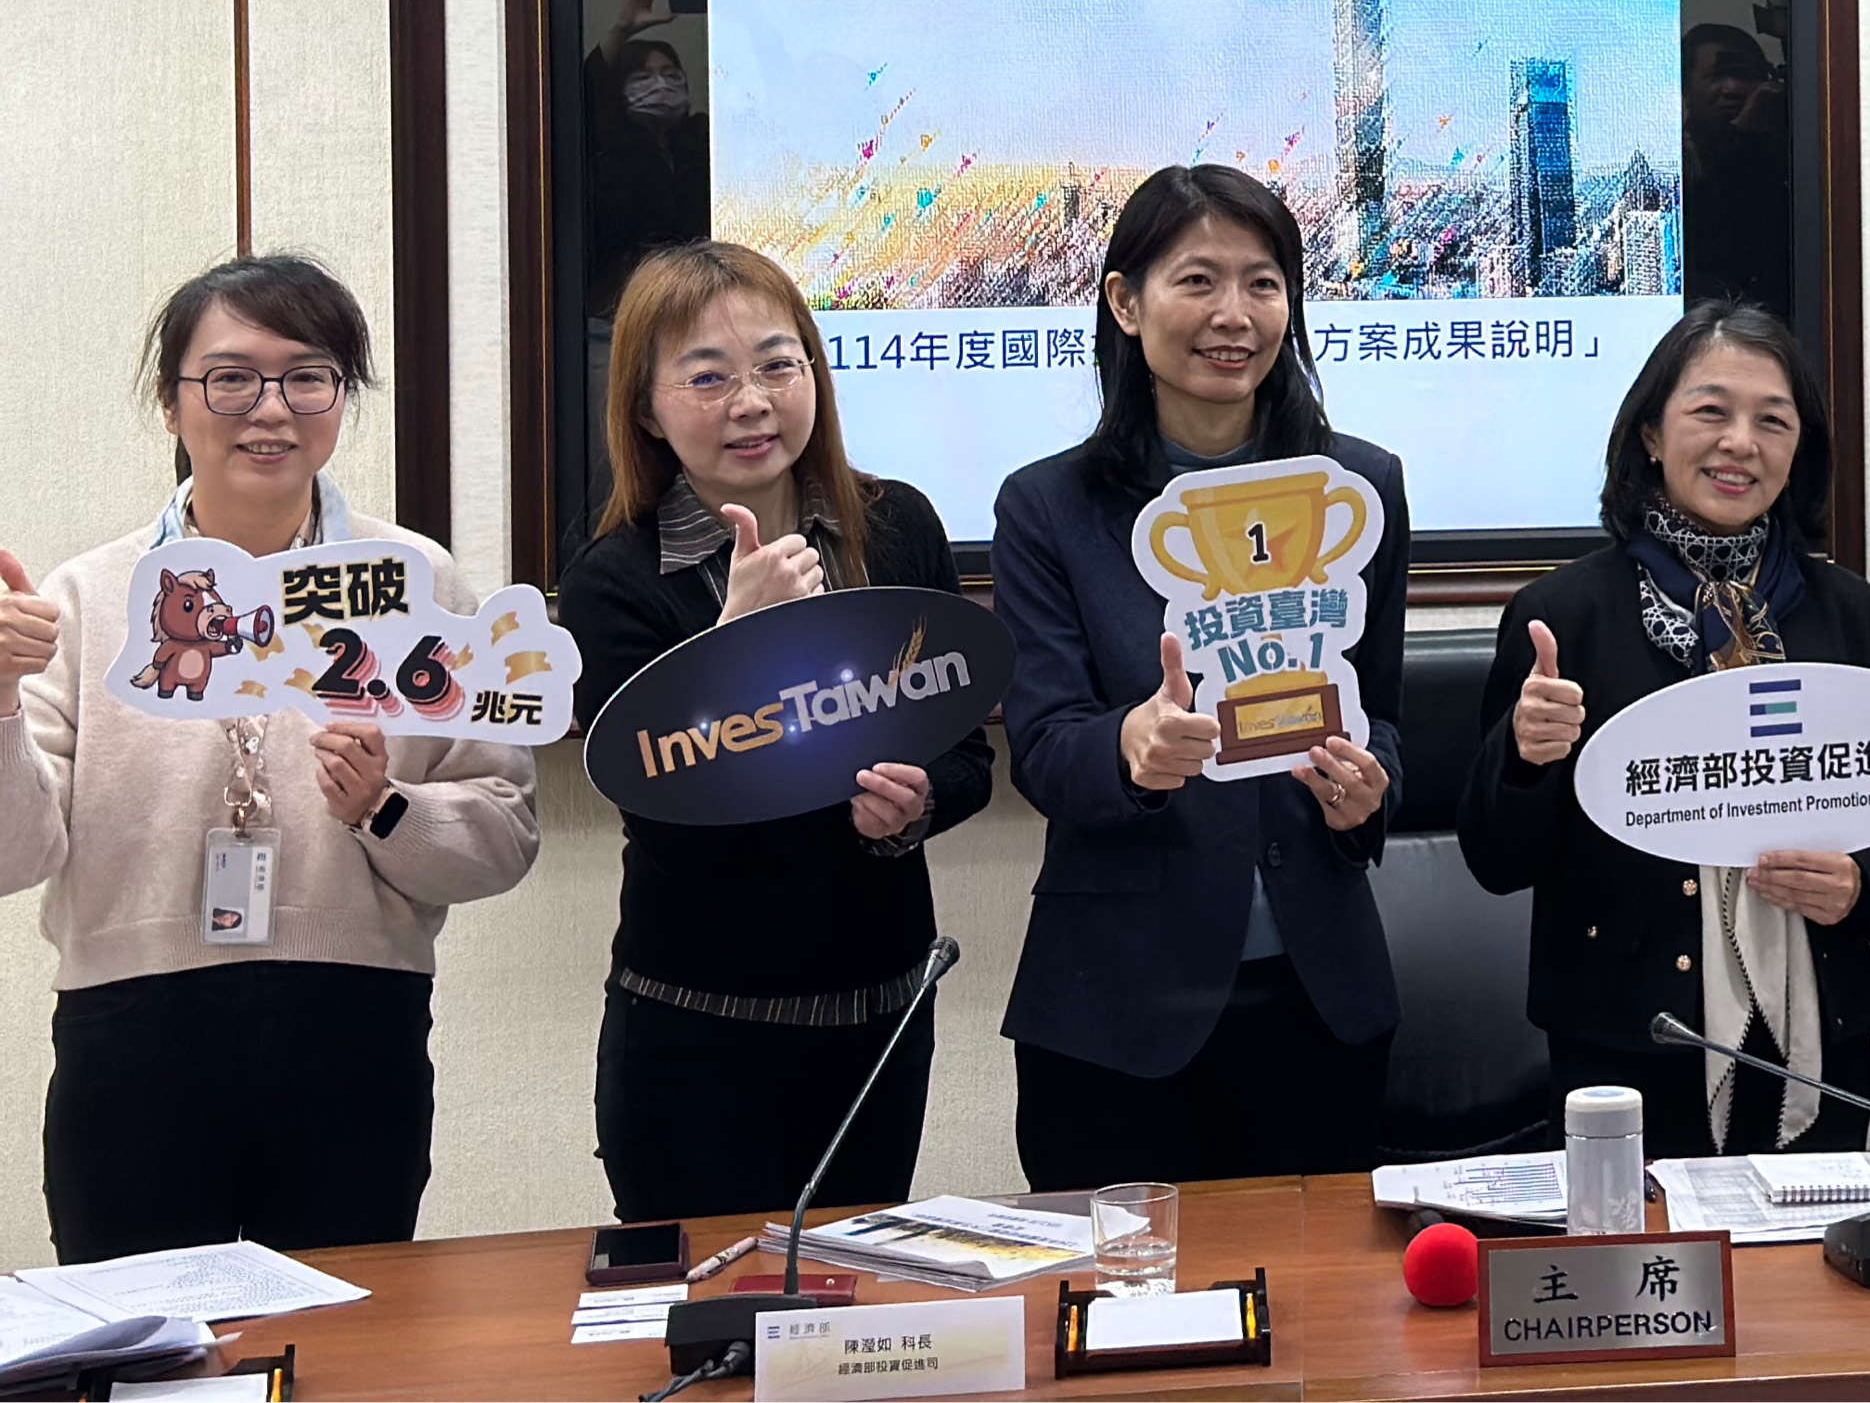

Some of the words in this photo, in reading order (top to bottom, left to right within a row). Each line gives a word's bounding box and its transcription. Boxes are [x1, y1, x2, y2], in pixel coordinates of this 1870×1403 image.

[828, 329, 1098, 370] 114年度國際
[1313, 320, 1600, 362] 方案成果說明」
[1247, 523, 1270, 562] 1
[282, 557, 411, 626] 突破
[1183, 588, 1348, 651] 投資臺灣
[311, 627, 460, 713] 2.6
[470, 690, 543, 726] 兆元
[636, 643, 972, 779] InvesTaiwan
[1625, 806, 1706, 829] Department
[1708, 802, 1724, 819] of
[1726, 797, 1803, 817] Investment
[789, 1322, 831, 1336] 經濟部
[901, 1333, 933, 1351] 科長
[1503, 1310, 1713, 1342] CHAIRPERSON
[838, 1356, 939, 1376] 經濟部投資促進司
